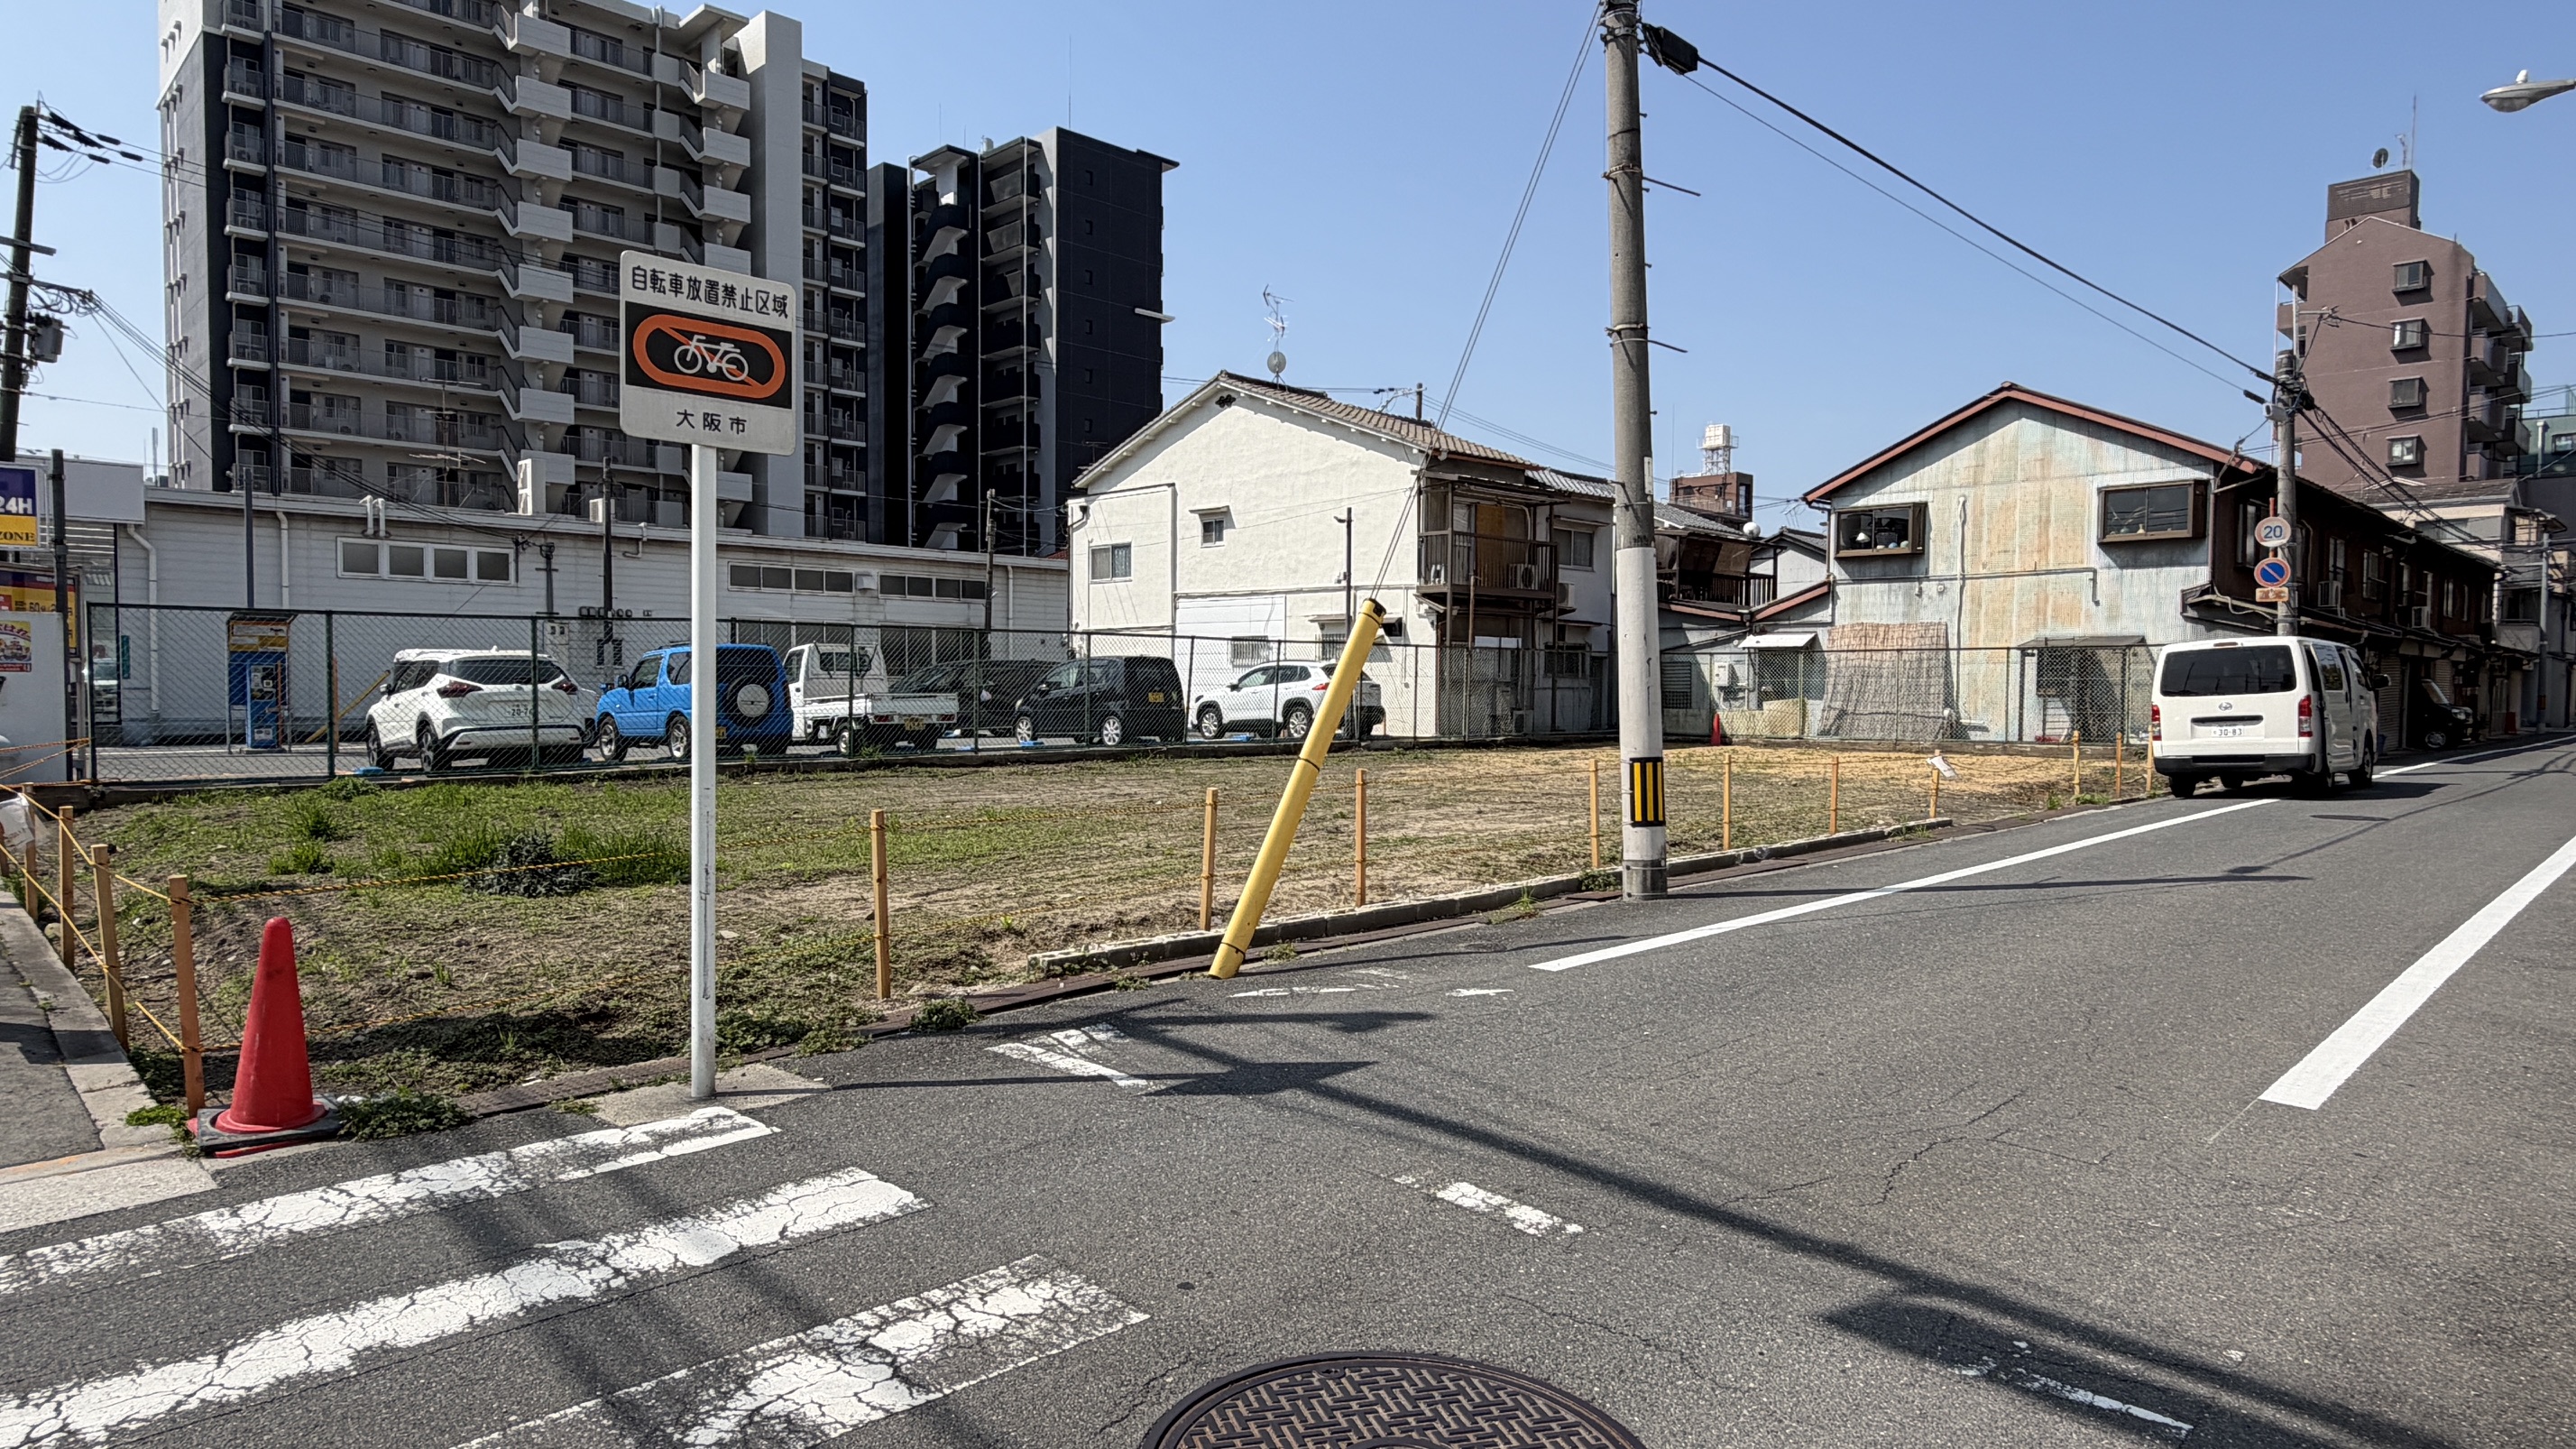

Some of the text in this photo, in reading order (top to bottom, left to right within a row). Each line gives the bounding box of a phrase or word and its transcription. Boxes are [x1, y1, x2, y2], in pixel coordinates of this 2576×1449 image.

[631, 264, 788, 319] 自転車放置禁止区域
[676, 409, 748, 435] 大阪市
[2263, 525, 2283, 539] 20
